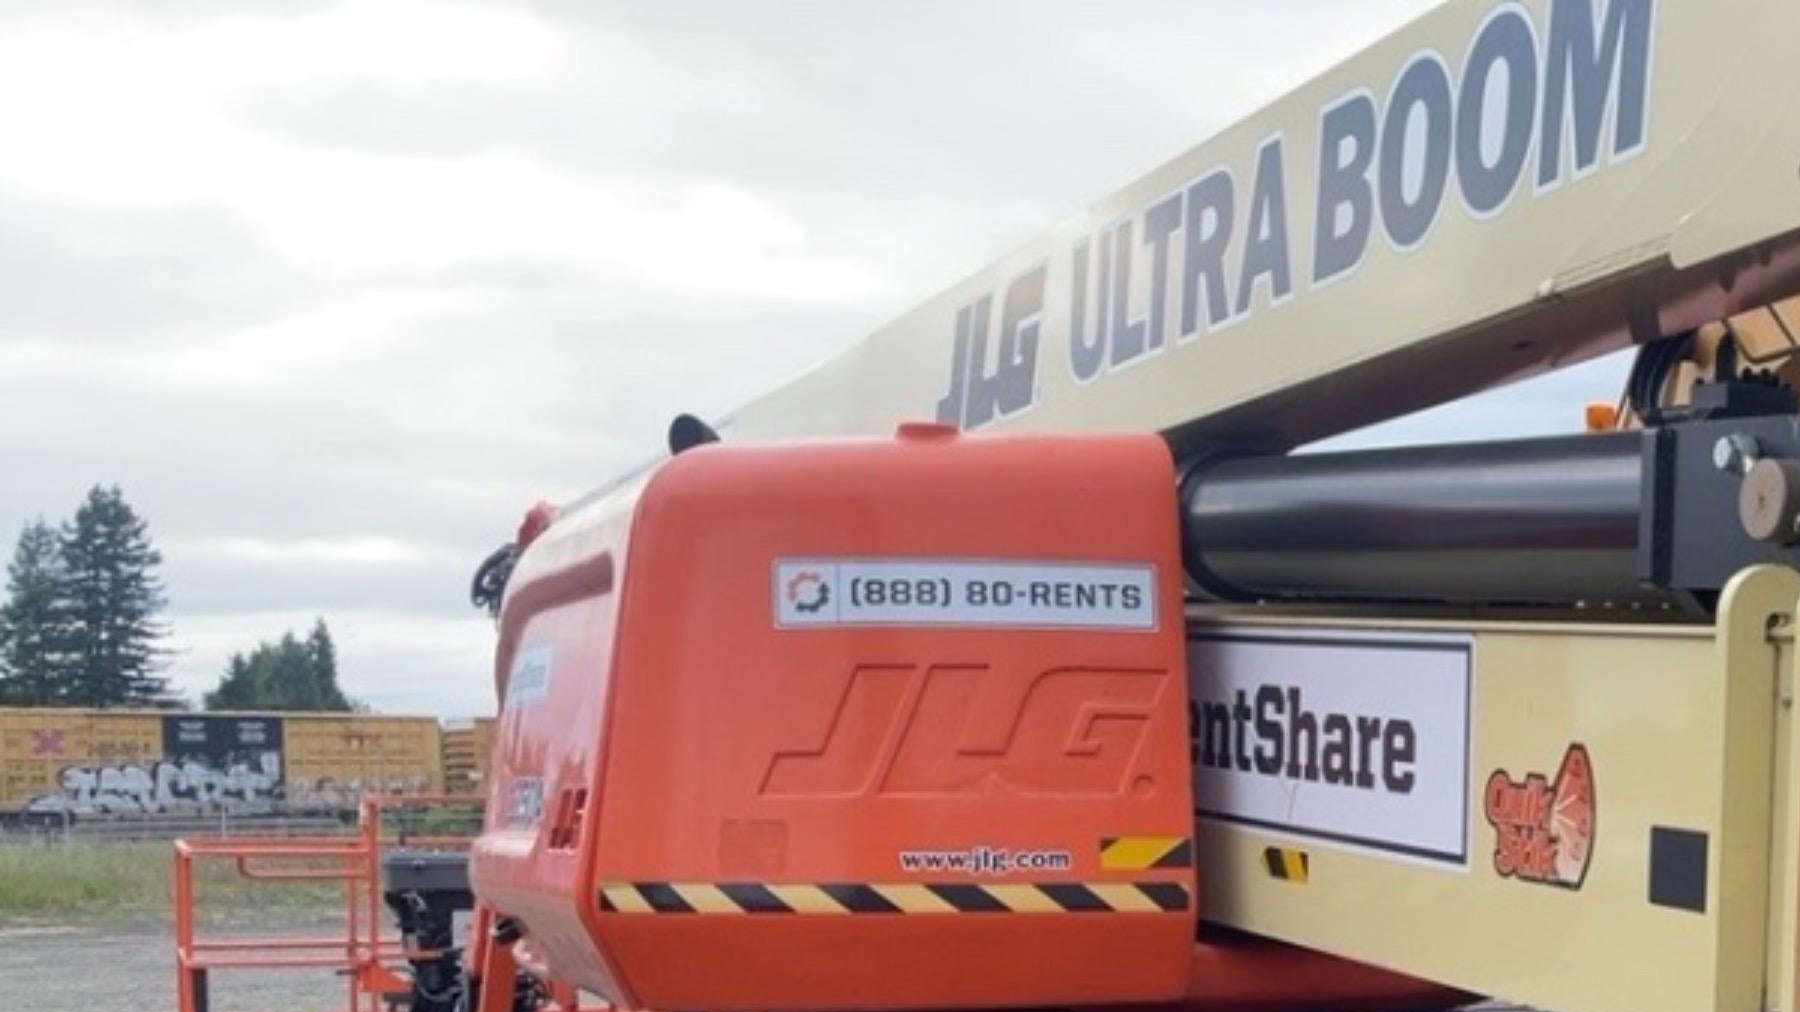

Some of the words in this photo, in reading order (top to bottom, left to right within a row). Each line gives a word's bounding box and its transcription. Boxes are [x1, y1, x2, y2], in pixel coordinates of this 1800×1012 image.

[934, 262, 1048, 432] JLG
[1068, 132, 1295, 388] ULTRA
[1310, 0, 1656, 290] BOOM
[850, 577, 951, 608] (888)
[965, 580, 1142, 610] 80-RENTS
[901, 848, 1071, 873] www.jlg.com
